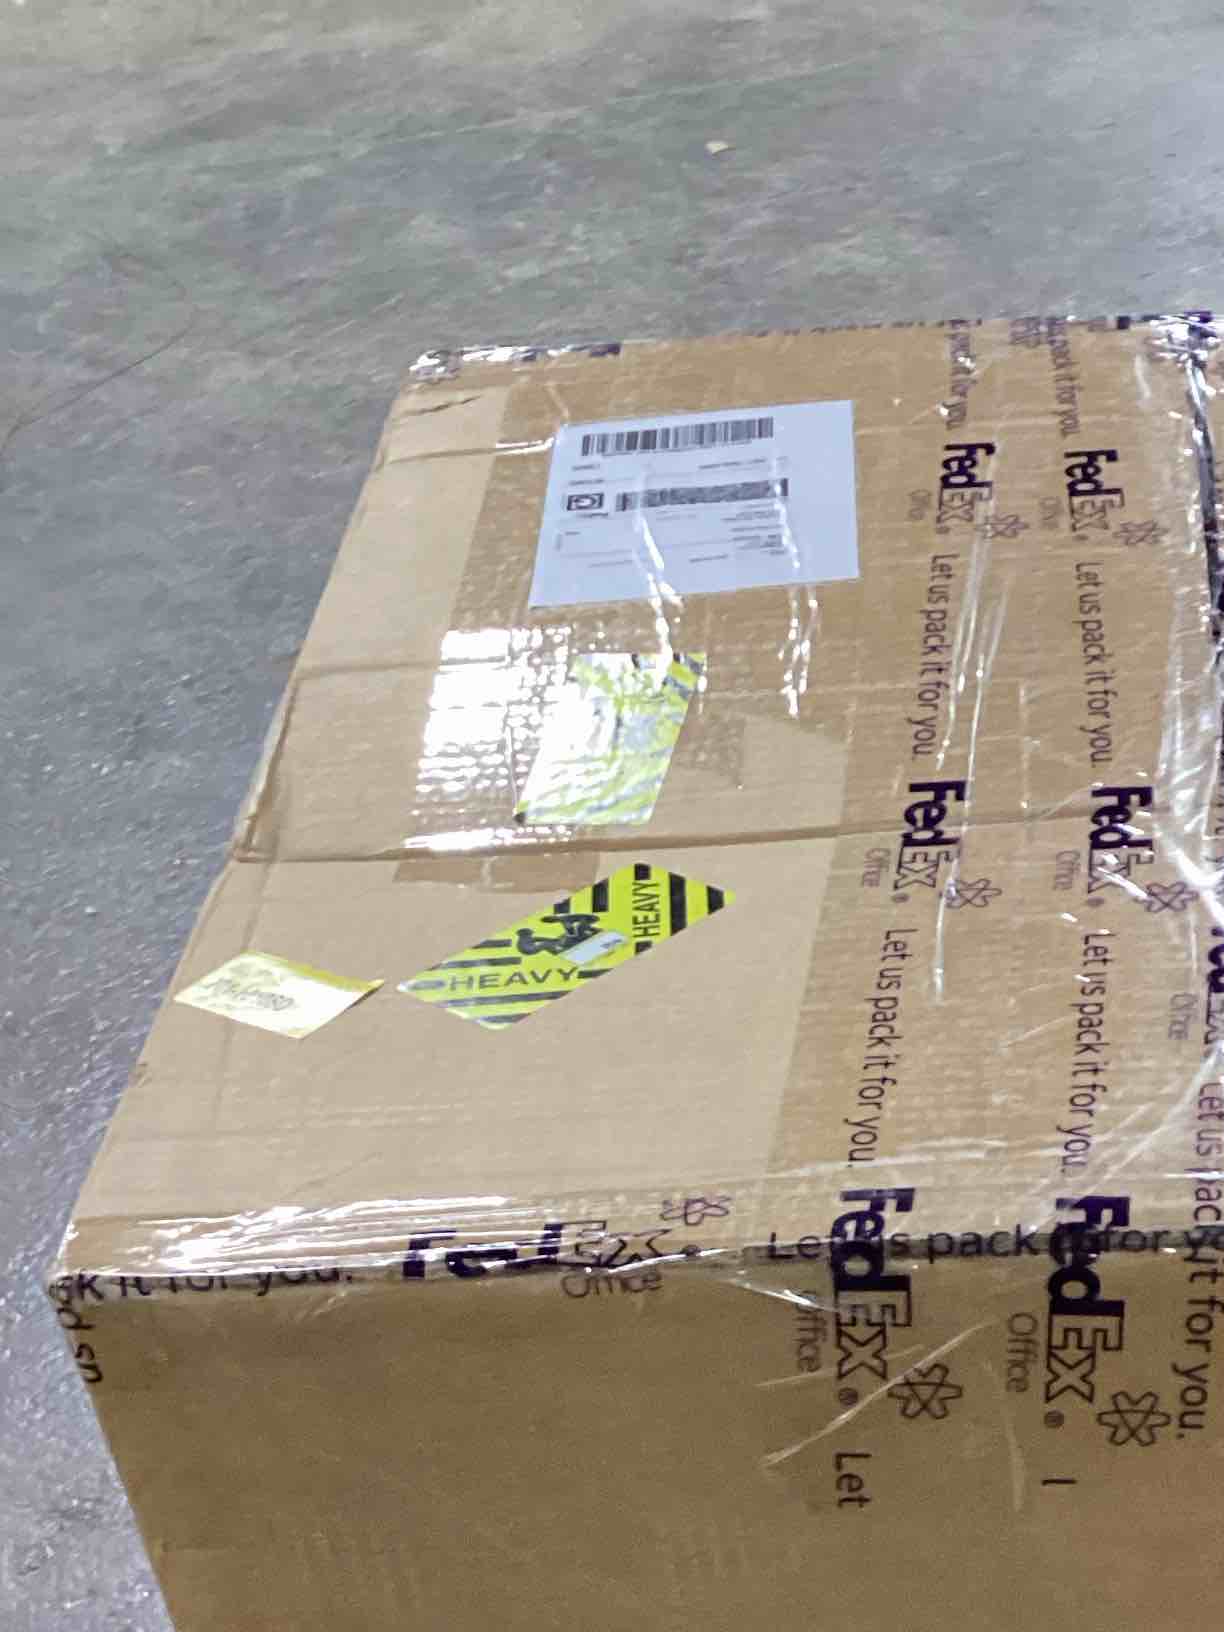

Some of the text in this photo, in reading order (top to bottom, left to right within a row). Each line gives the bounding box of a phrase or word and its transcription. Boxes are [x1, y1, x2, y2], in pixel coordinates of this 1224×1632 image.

[936, 442, 996, 524] FedEx
[1063, 449, 1125, 533] FedEx
[930, 554, 960, 581] Let
[1075, 561, 1104, 587] Let
[927, 585, 950, 604] us
[1079, 590, 1101, 615] us
[920, 609, 953, 663] pack
[1072, 619, 1116, 665] pack
[920, 663, 950, 676] it
[1086, 669, 1118, 690] it
[917, 680, 950, 711] for
[1087, 690, 1118, 719] for
[893, 779, 966, 891] FedEx
[1088, 785, 1154, 894] FedEx
[632, 880, 662, 938] HEAVY
[881, 929, 919, 961] Let
[1082, 933, 1117, 966] Let
[449, 966, 581, 992] HEAVY
[877, 967, 904, 991] us
[1081, 973, 1107, 997] us
[864, 996, 904, 1048] pack
[1069, 1002, 1110, 1055] pack
[863, 1053, 901, 1070] it
[1072, 1061, 1110, 1077] it
[858, 1076, 898, 1110] for
[1069, 1084, 1107, 1118] for
[1196, 1132, 1223, 1157] us
[928, 1224, 1038, 1264] pack
[1006, 1311, 1039, 1393] Office
[834, 1452, 872, 1508] Let
